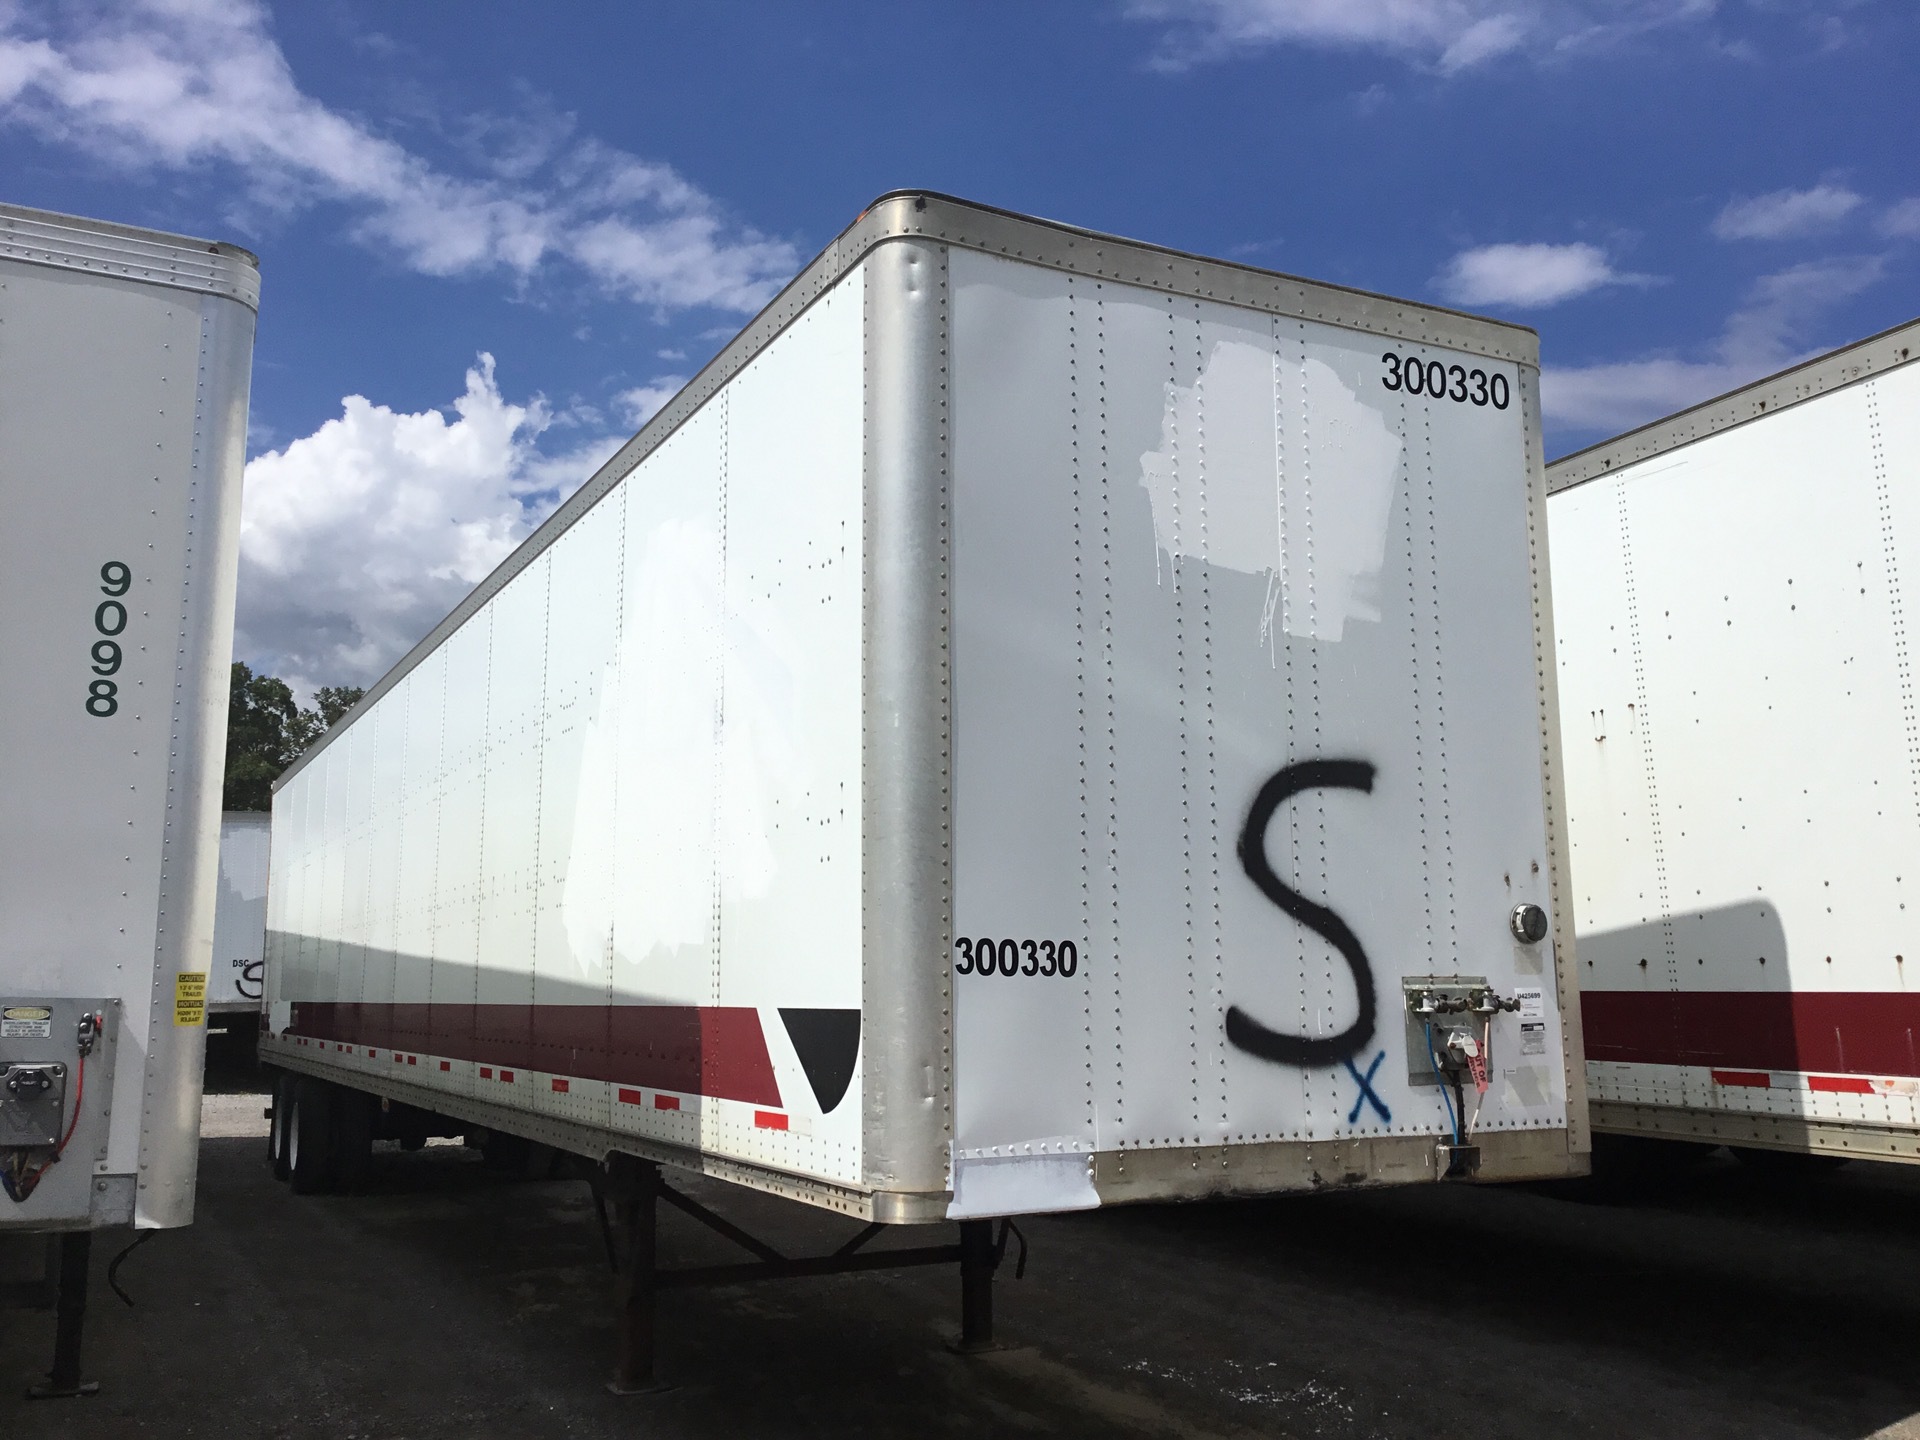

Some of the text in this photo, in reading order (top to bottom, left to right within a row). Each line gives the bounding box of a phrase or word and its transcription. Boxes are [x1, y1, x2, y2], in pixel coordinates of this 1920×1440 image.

[1382, 352, 1510, 410] 300330
[85, 561, 131, 718] 9098
[1224, 759, 1378, 1069] S
[955, 937, 1077, 977] 300330
[1479, 1070, 1486, 1082] OF
